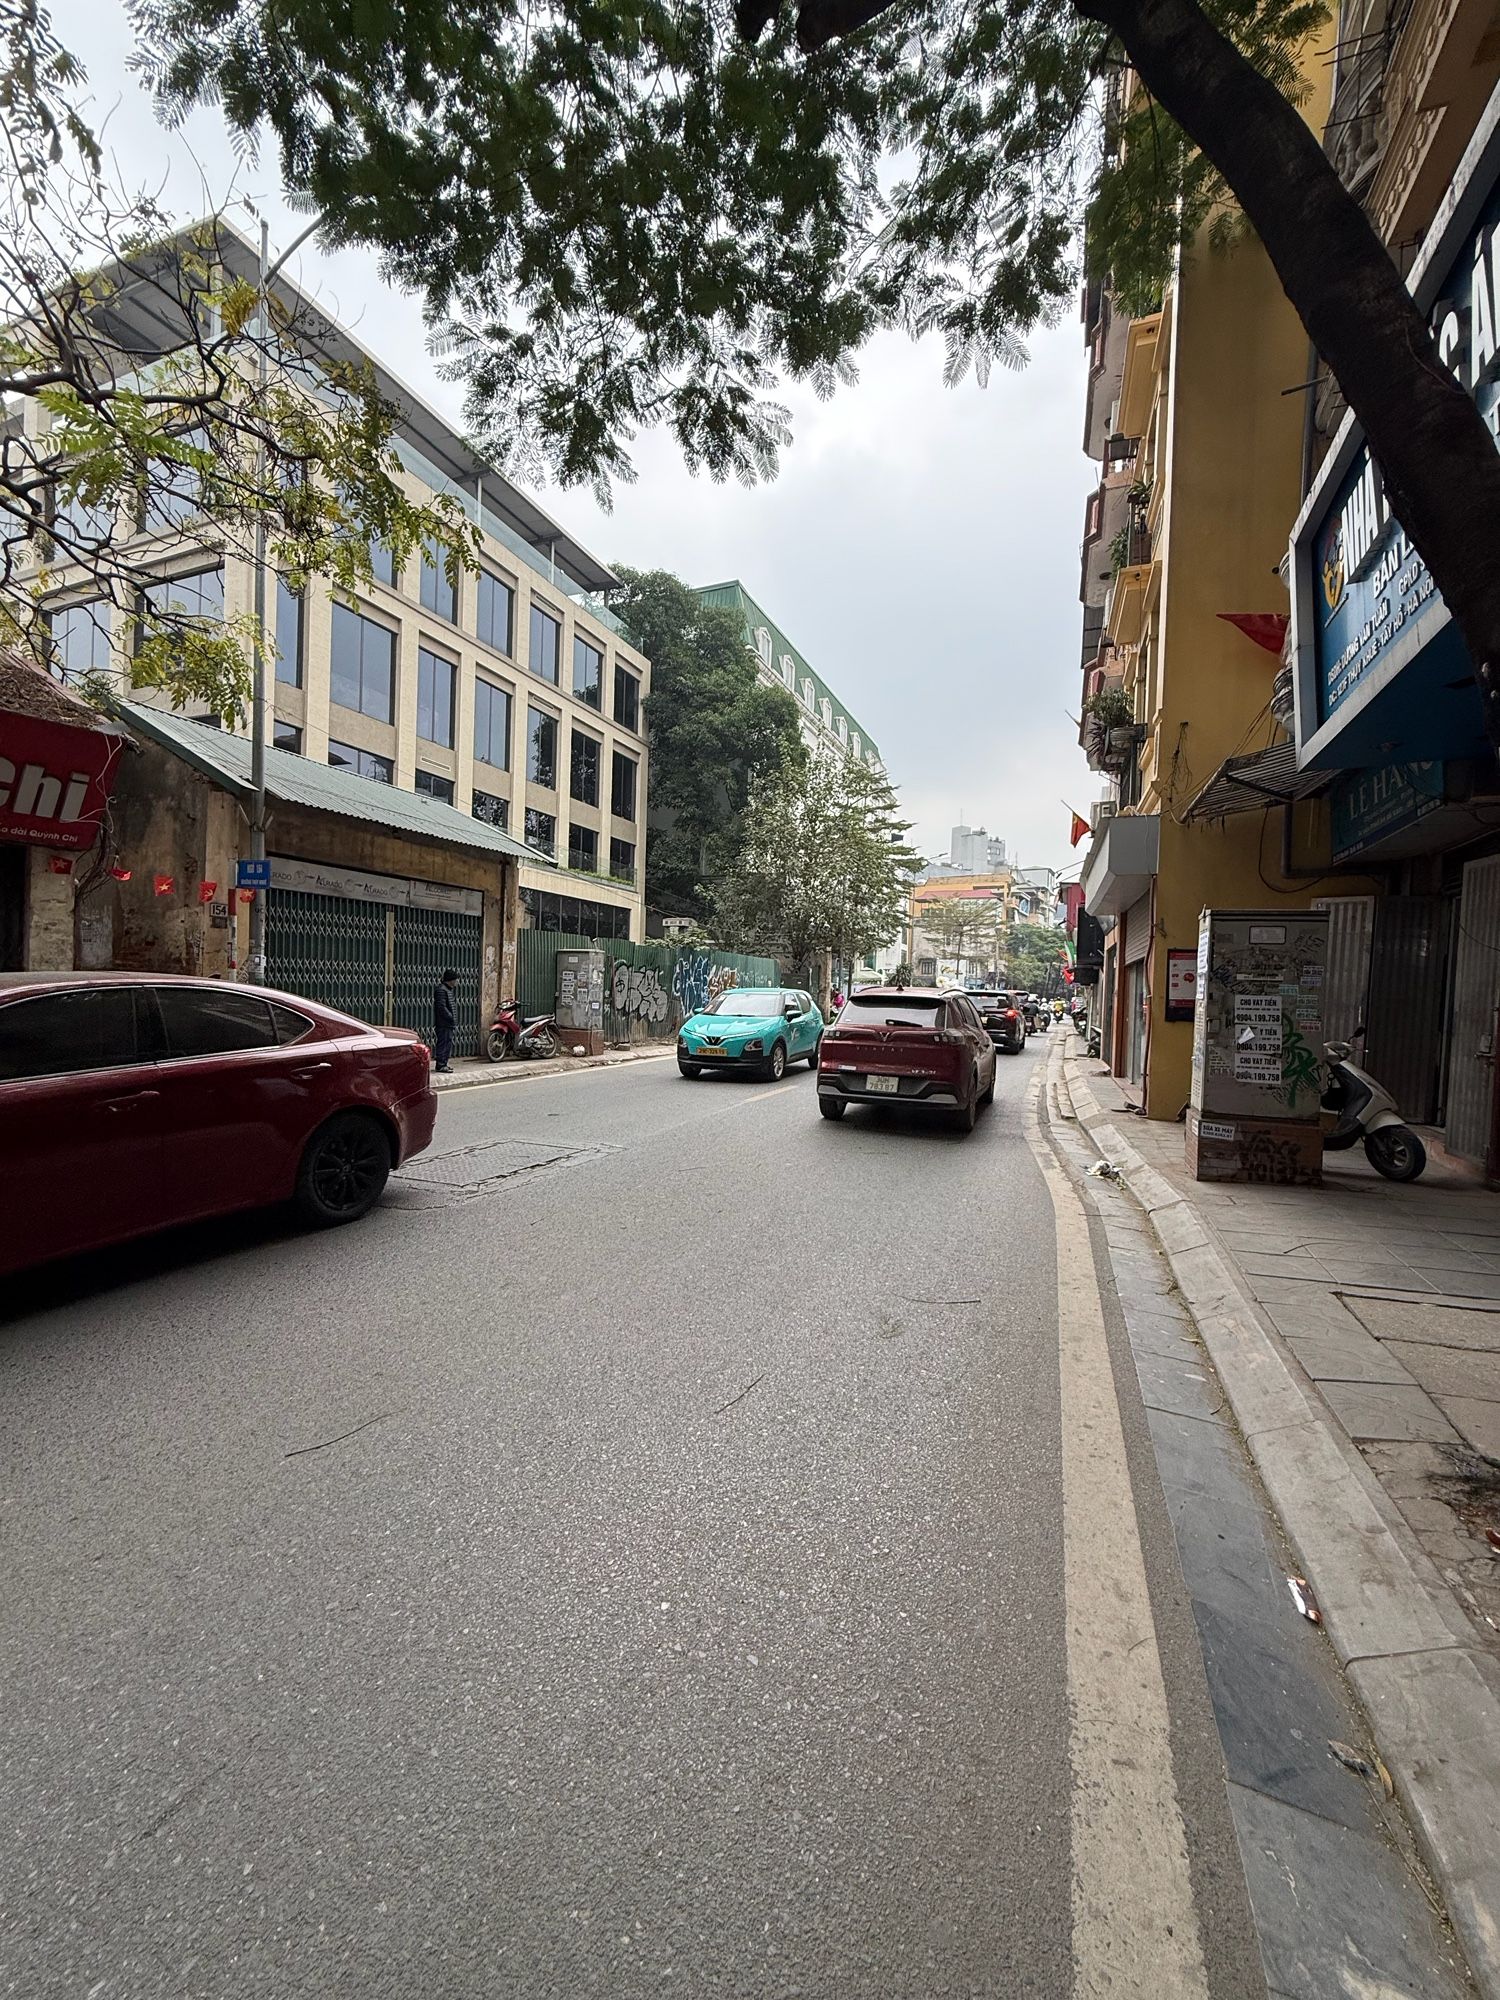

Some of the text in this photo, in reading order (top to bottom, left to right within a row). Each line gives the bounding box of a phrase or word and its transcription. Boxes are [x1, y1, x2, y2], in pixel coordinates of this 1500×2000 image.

[1341, 445, 1379, 585] NHÀ
[1373, 543, 1399, 599] BÁN
[1380, 622, 1393, 646] TÂY
[1393, 605, 1404, 632] HỒ
[1407, 590, 1418, 615] HÀ
[1420, 574, 1434, 603] NỘI
[10, 826, 27, 836] dài
[61, 833, 78, 843] Chi
[212, 904, 226, 915] 154
[1240, 998, 1251, 1006] CHO
[1252, 998, 1263, 1007] VAY
[1236, 1043, 1280, 1052] 0904.199.758
[1240, 1057, 1251, 1065] CHO
[1252, 1057, 1263, 1065] VAY
